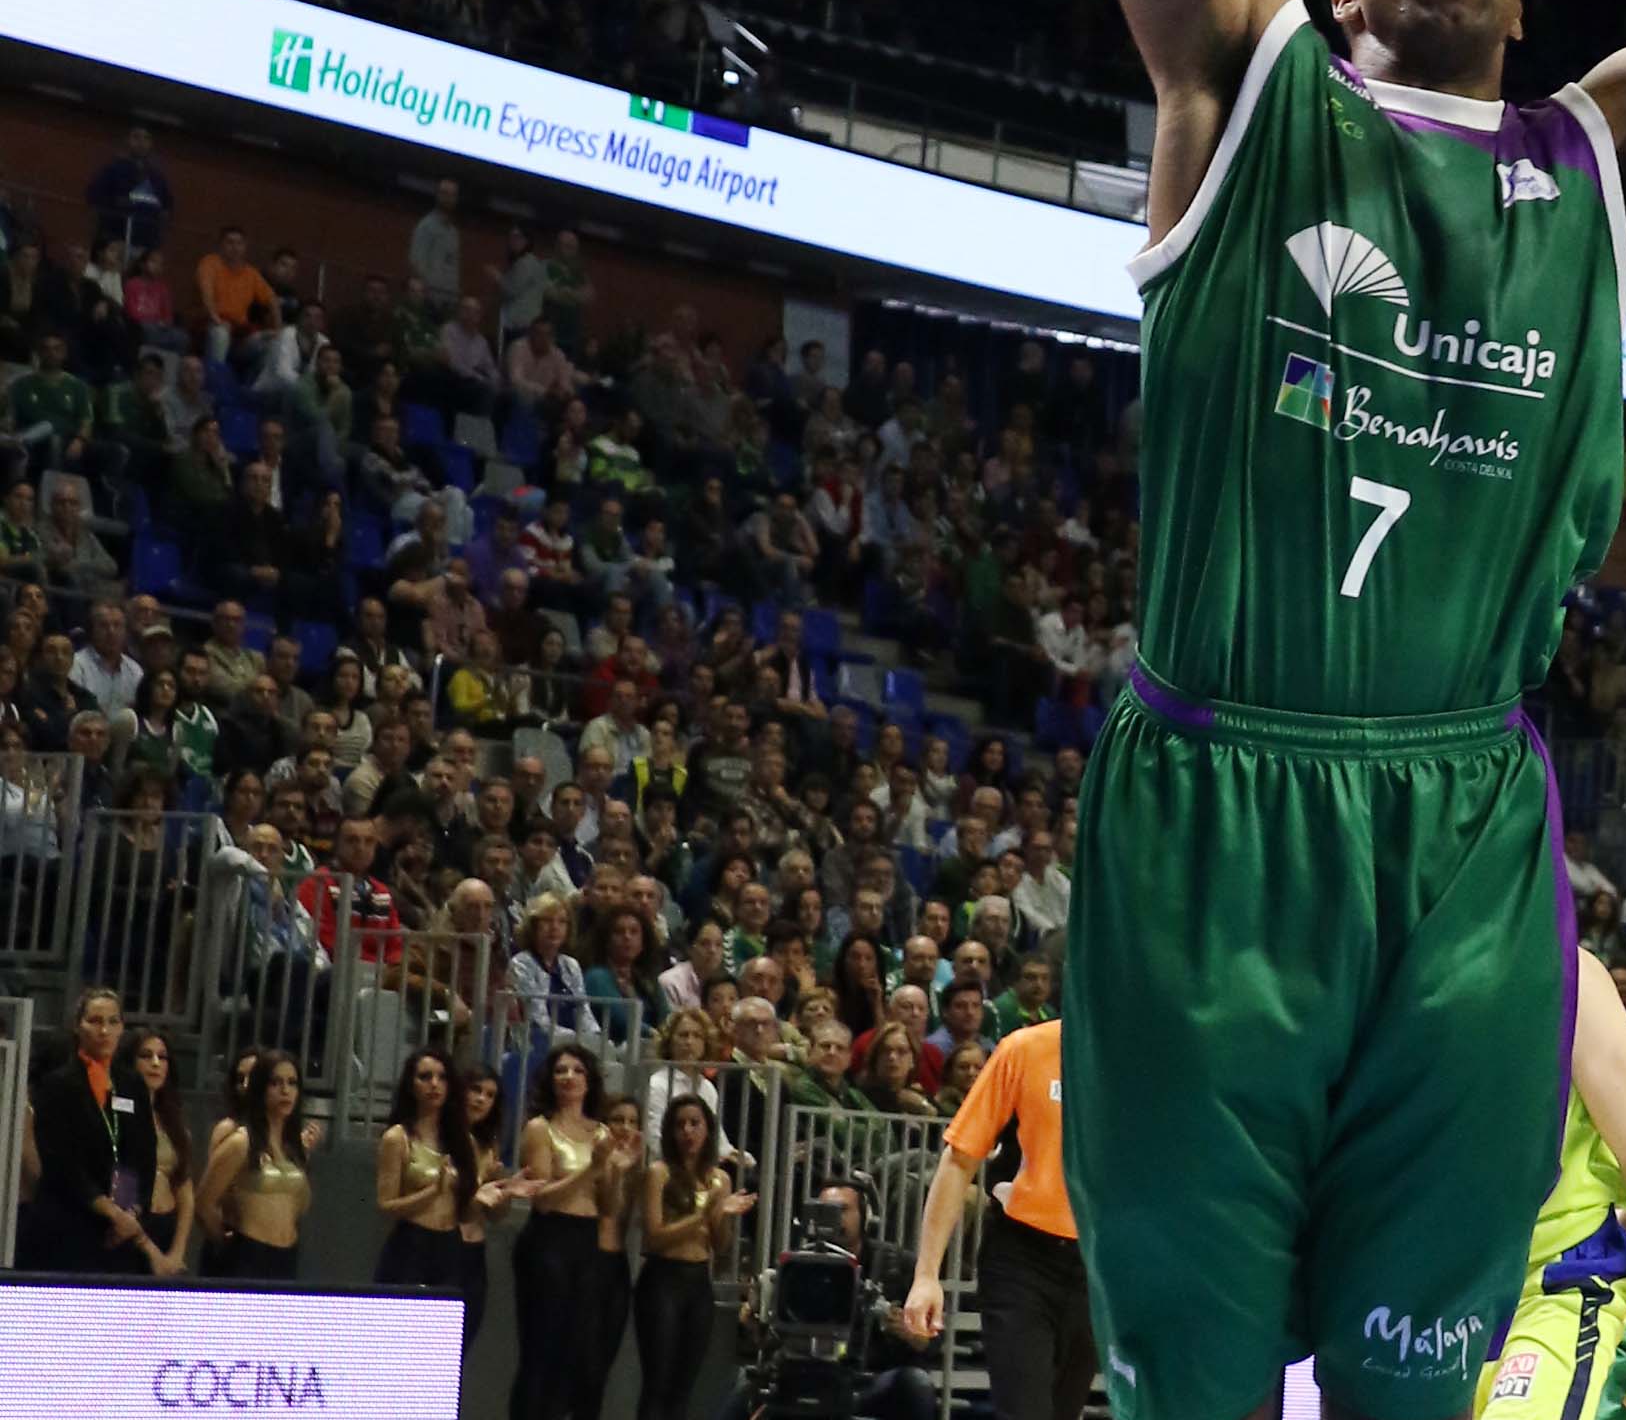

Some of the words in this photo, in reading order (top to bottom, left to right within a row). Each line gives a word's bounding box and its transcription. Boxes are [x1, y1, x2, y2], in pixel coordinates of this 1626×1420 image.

[319, 49, 439, 126] Holiday
[443, 82, 491, 131] Inn
[498, 101, 600, 159] Express
[602, 131, 692, 188] Málaga
[695, 156, 779, 206] Airport
[1393, 312, 1556, 387] Unicaja
[1340, 475, 1411, 598] 7
[153, 1360, 326, 1407] COCINA
